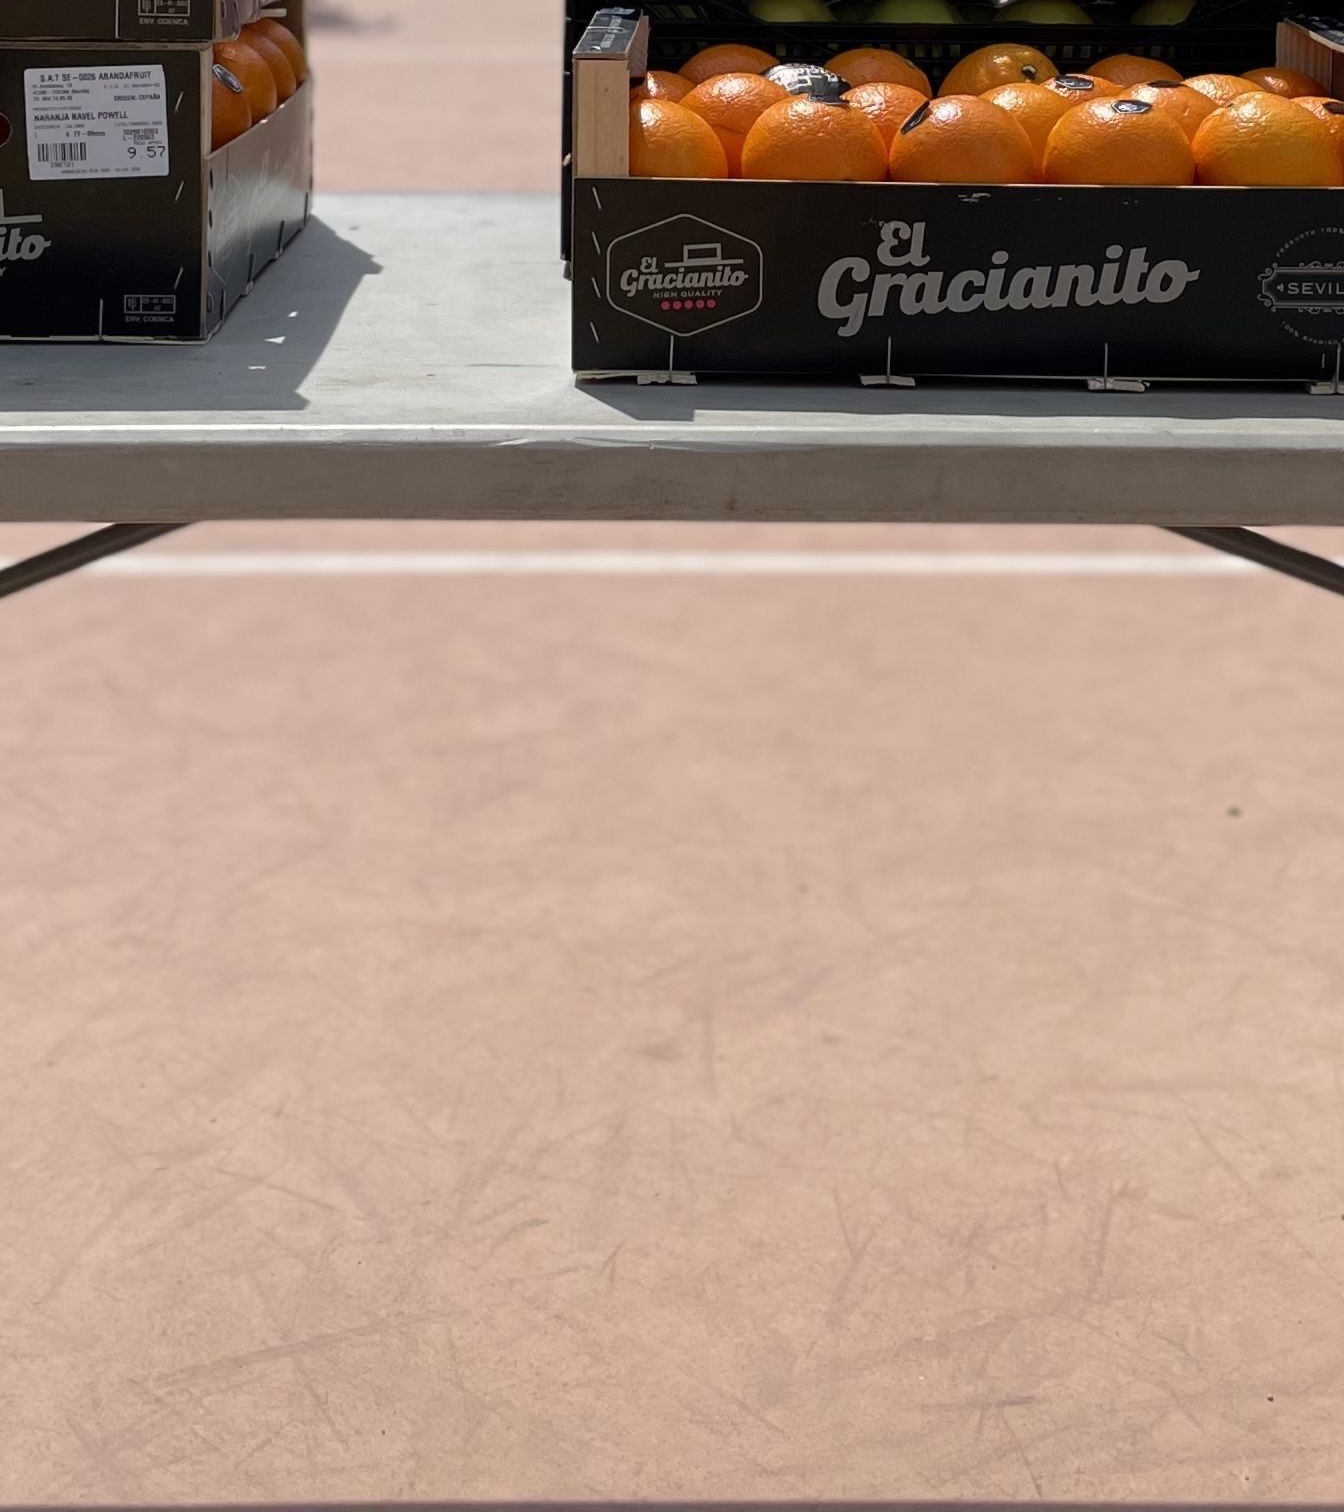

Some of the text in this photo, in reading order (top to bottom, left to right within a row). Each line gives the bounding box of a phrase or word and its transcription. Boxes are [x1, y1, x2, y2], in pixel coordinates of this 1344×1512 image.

[98, 71, 152, 81] ARANDAFRUIT
[34, 111, 129, 121] NARANJA NAVEL POWELL
[877, 220, 930, 267] El
[640, 256, 659, 273] El
[620, 265, 750, 297] Gracianito
[653, 288, 723, 299] HIGH QUALITY
[818, 244, 1201, 338] Gracianito
